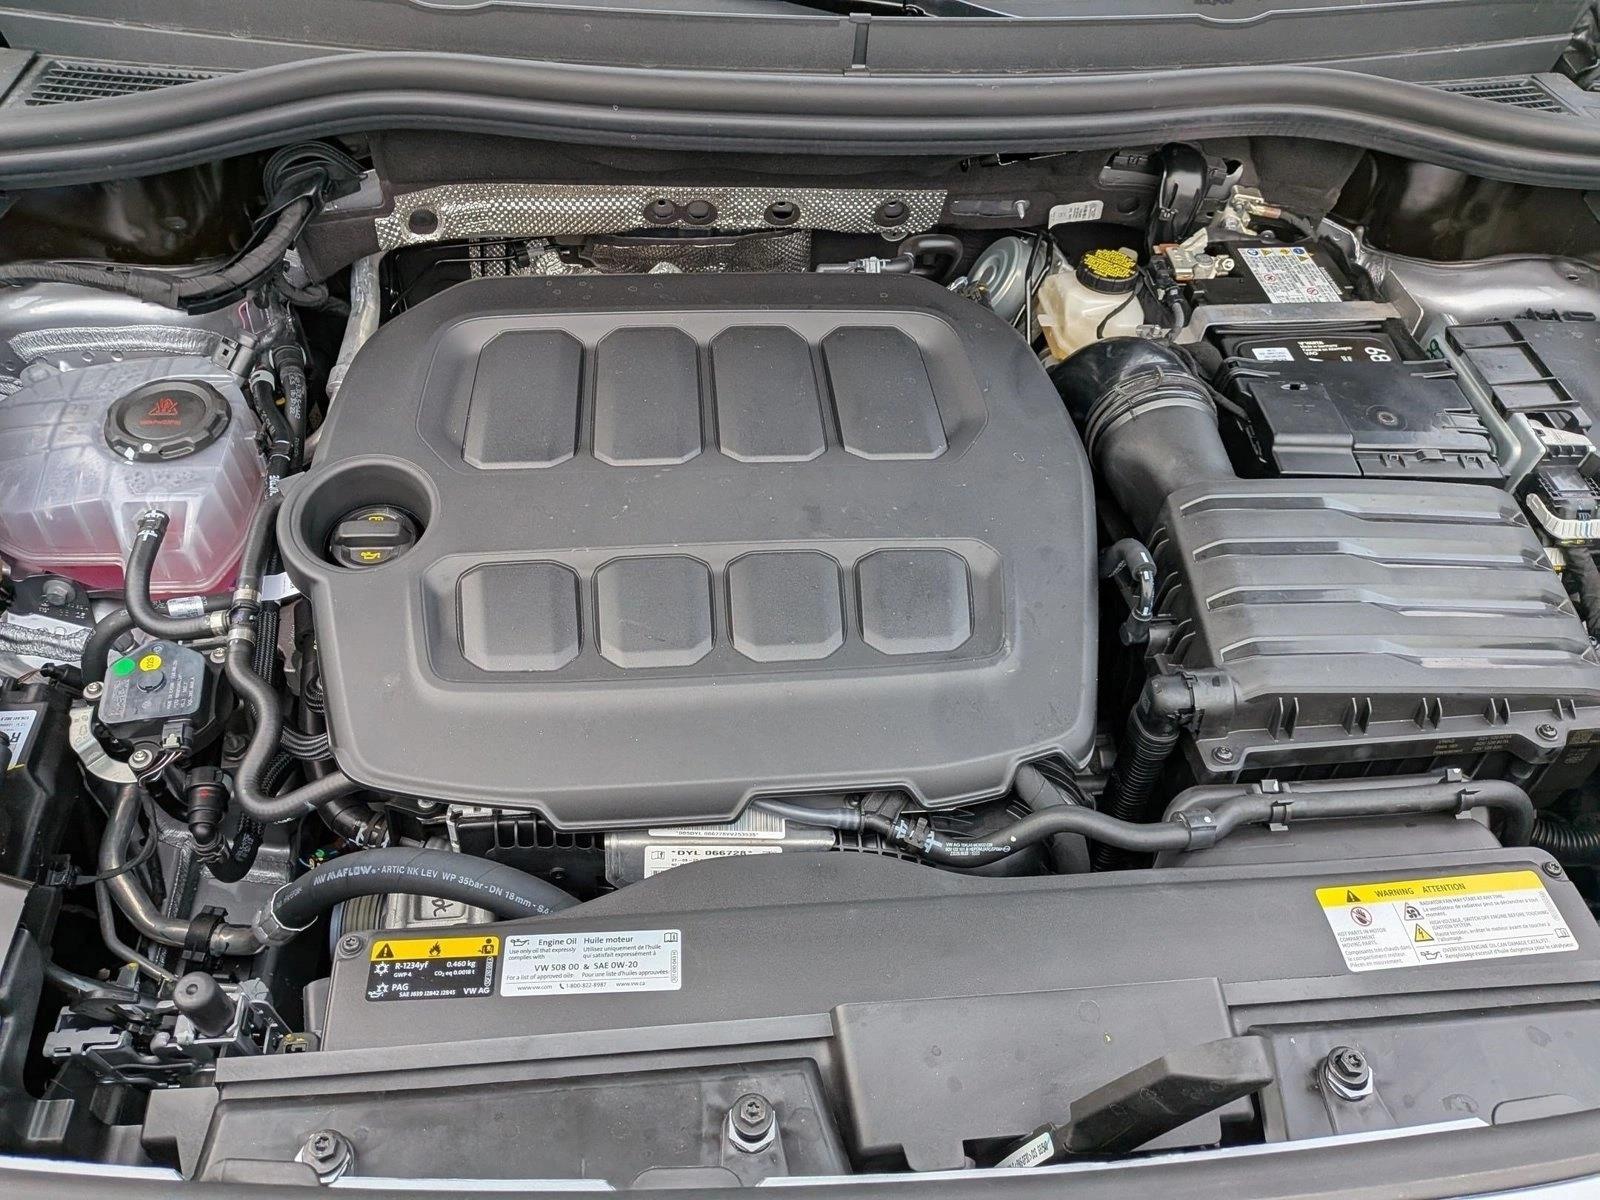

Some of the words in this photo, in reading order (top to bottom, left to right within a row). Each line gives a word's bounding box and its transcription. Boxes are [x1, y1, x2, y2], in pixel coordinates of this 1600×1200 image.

[381, 865, 405, 874] ARTIC
[406, 867, 419, 876] NK
[421, 869, 438, 878] LEV
[442, 872, 457, 882] WP
[489, 885, 503, 896] DN
[1374, 887, 1414, 897] WARNING
[1423, 883, 1466, 893] ATTENTION
[538, 939, 565, 947] Engine
[395, 961, 429, 971] R-1234yf
[467, 960, 476, 968] kg
[391, 983, 409, 991] PAG
[463, 987, 478, 995] VW
